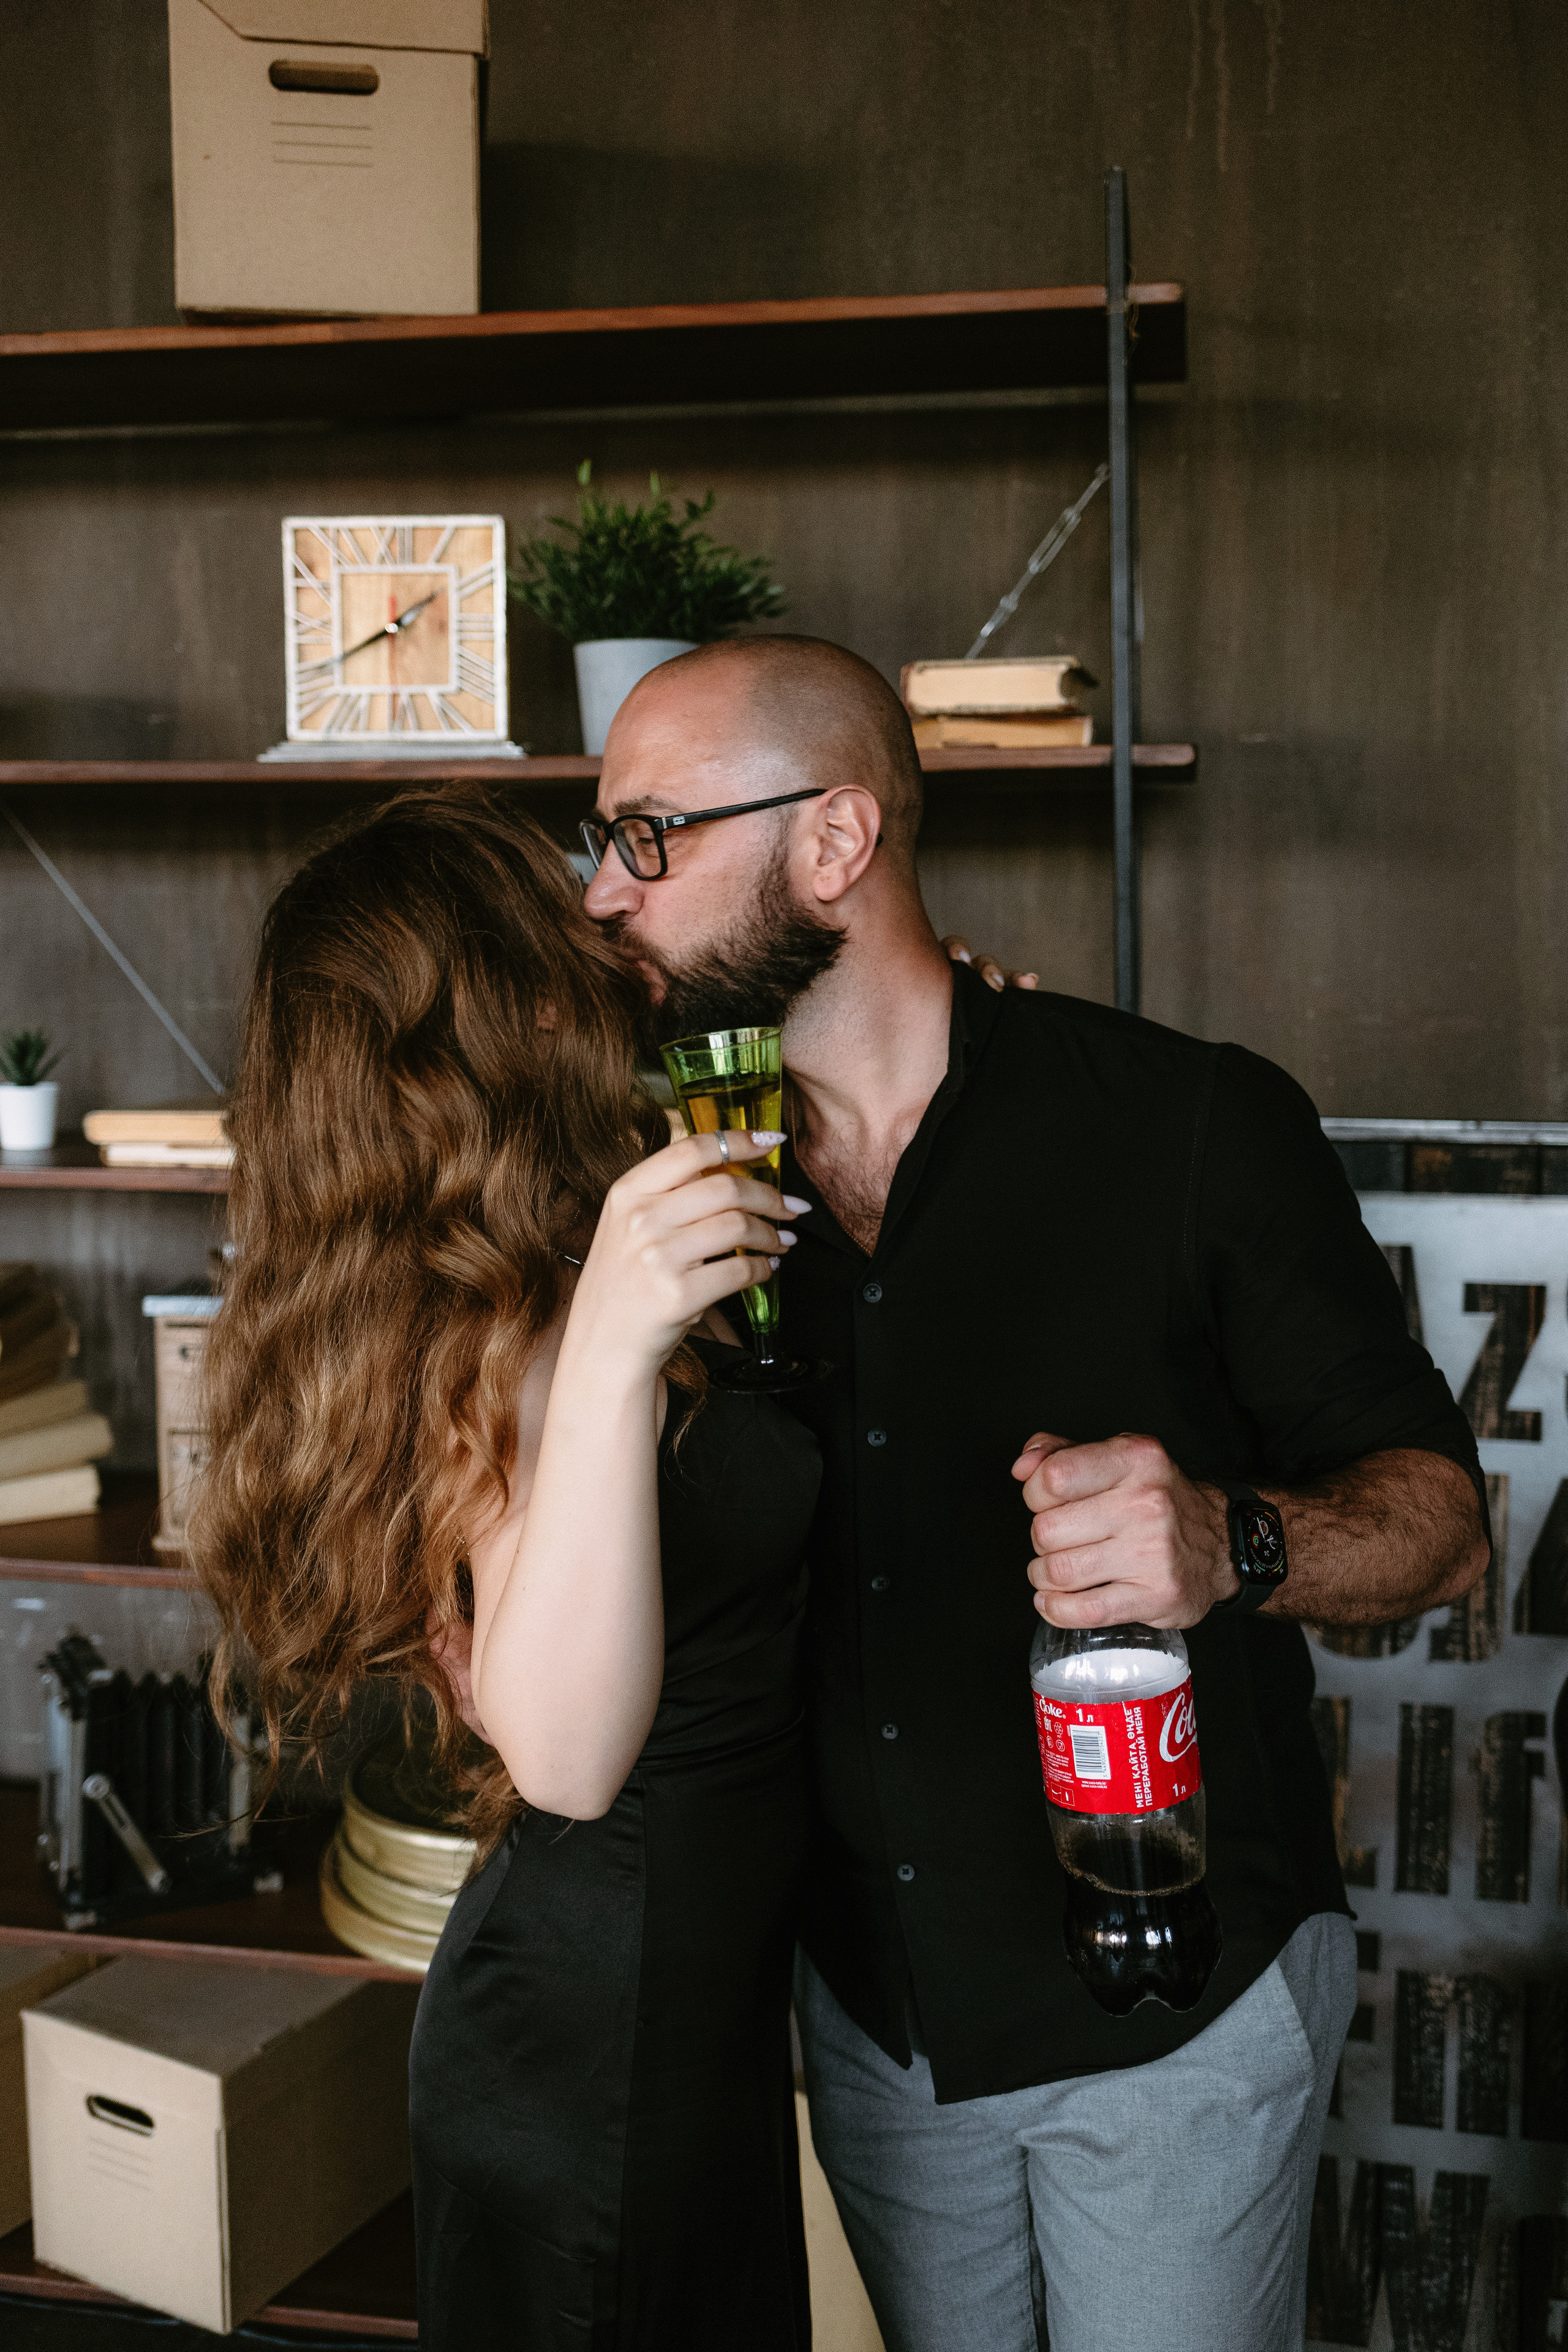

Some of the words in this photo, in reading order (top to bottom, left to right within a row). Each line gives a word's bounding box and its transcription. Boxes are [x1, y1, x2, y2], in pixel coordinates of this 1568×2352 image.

[1076, 1708, 1084, 1722] 1
[1133, 1706, 1144, 1735] МЕНЯ
[1135, 1736, 1153, 1807] ПЕРЕРАБОТАЙ
[1134, 1782, 1144, 1808] МЕНІ
[1172, 1783, 1179, 1797] 1
